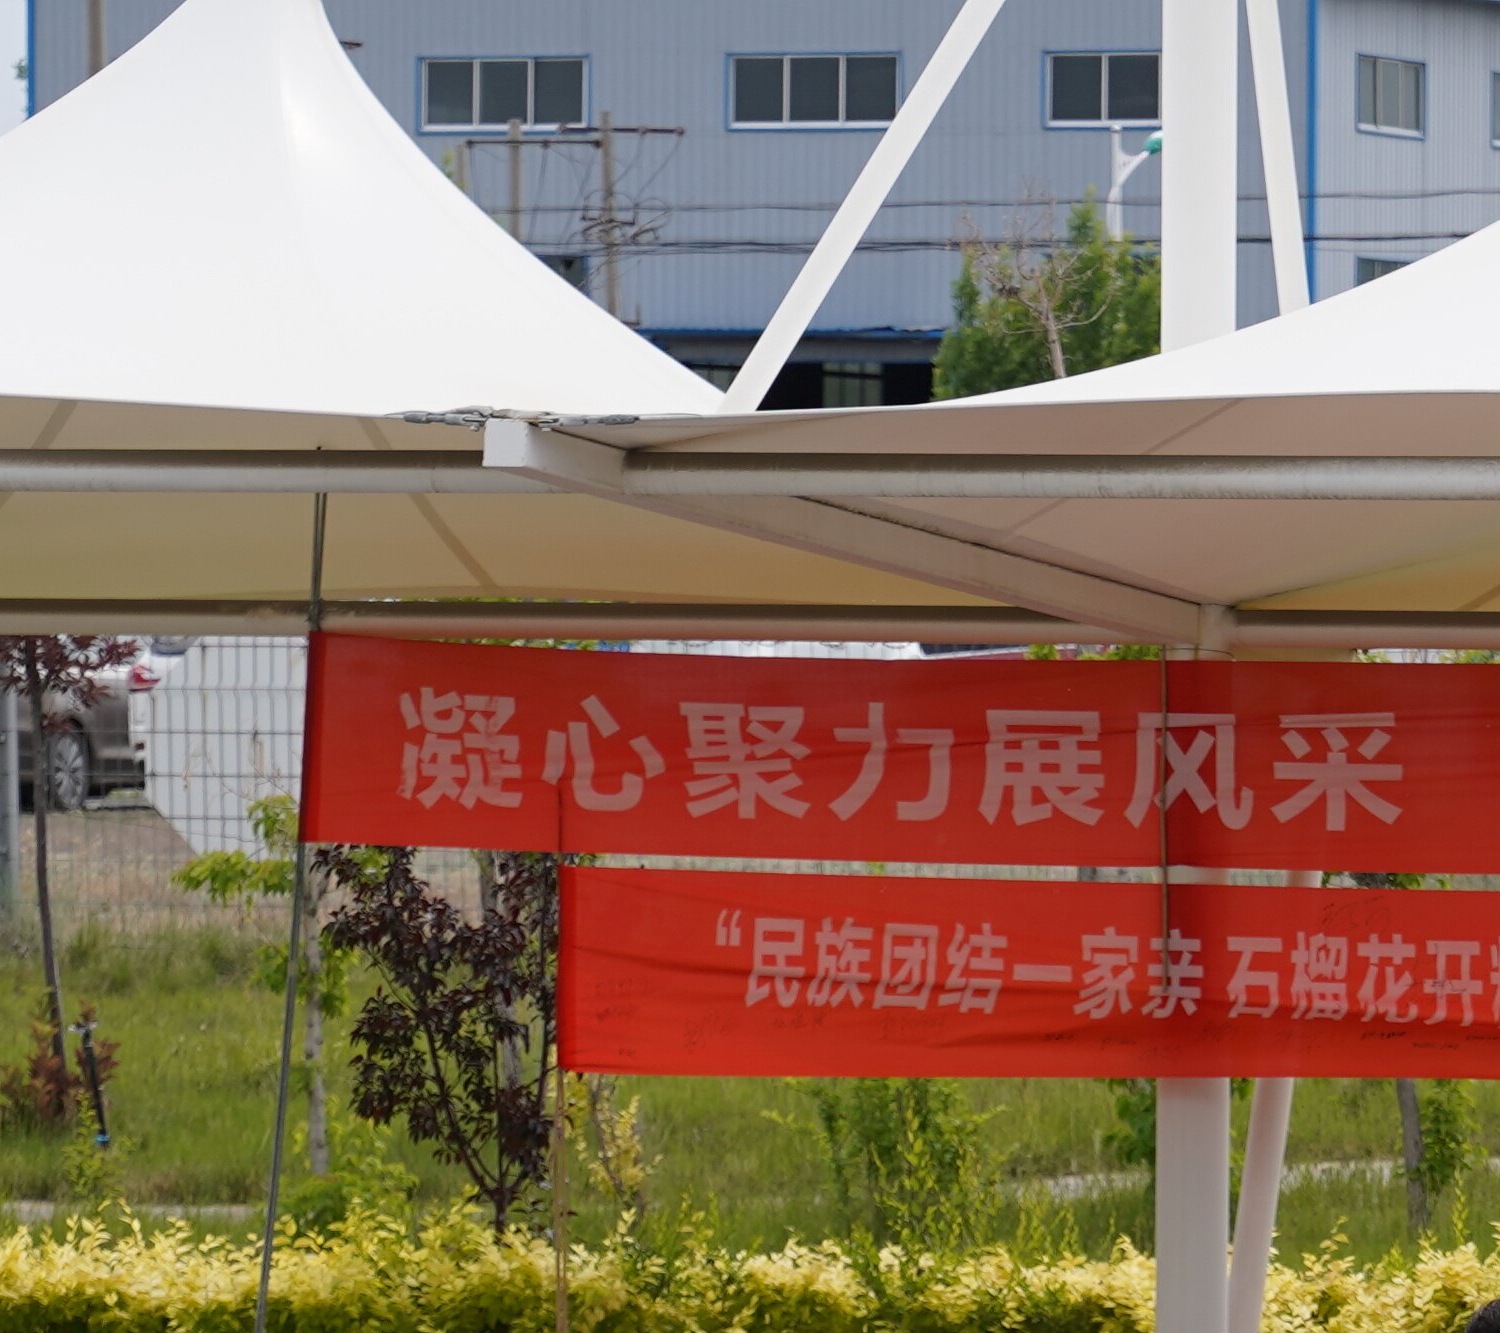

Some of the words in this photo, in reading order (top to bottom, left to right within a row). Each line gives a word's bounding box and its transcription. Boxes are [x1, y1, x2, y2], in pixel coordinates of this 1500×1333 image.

[397, 684, 1406, 833] 凝心聚力展风采
